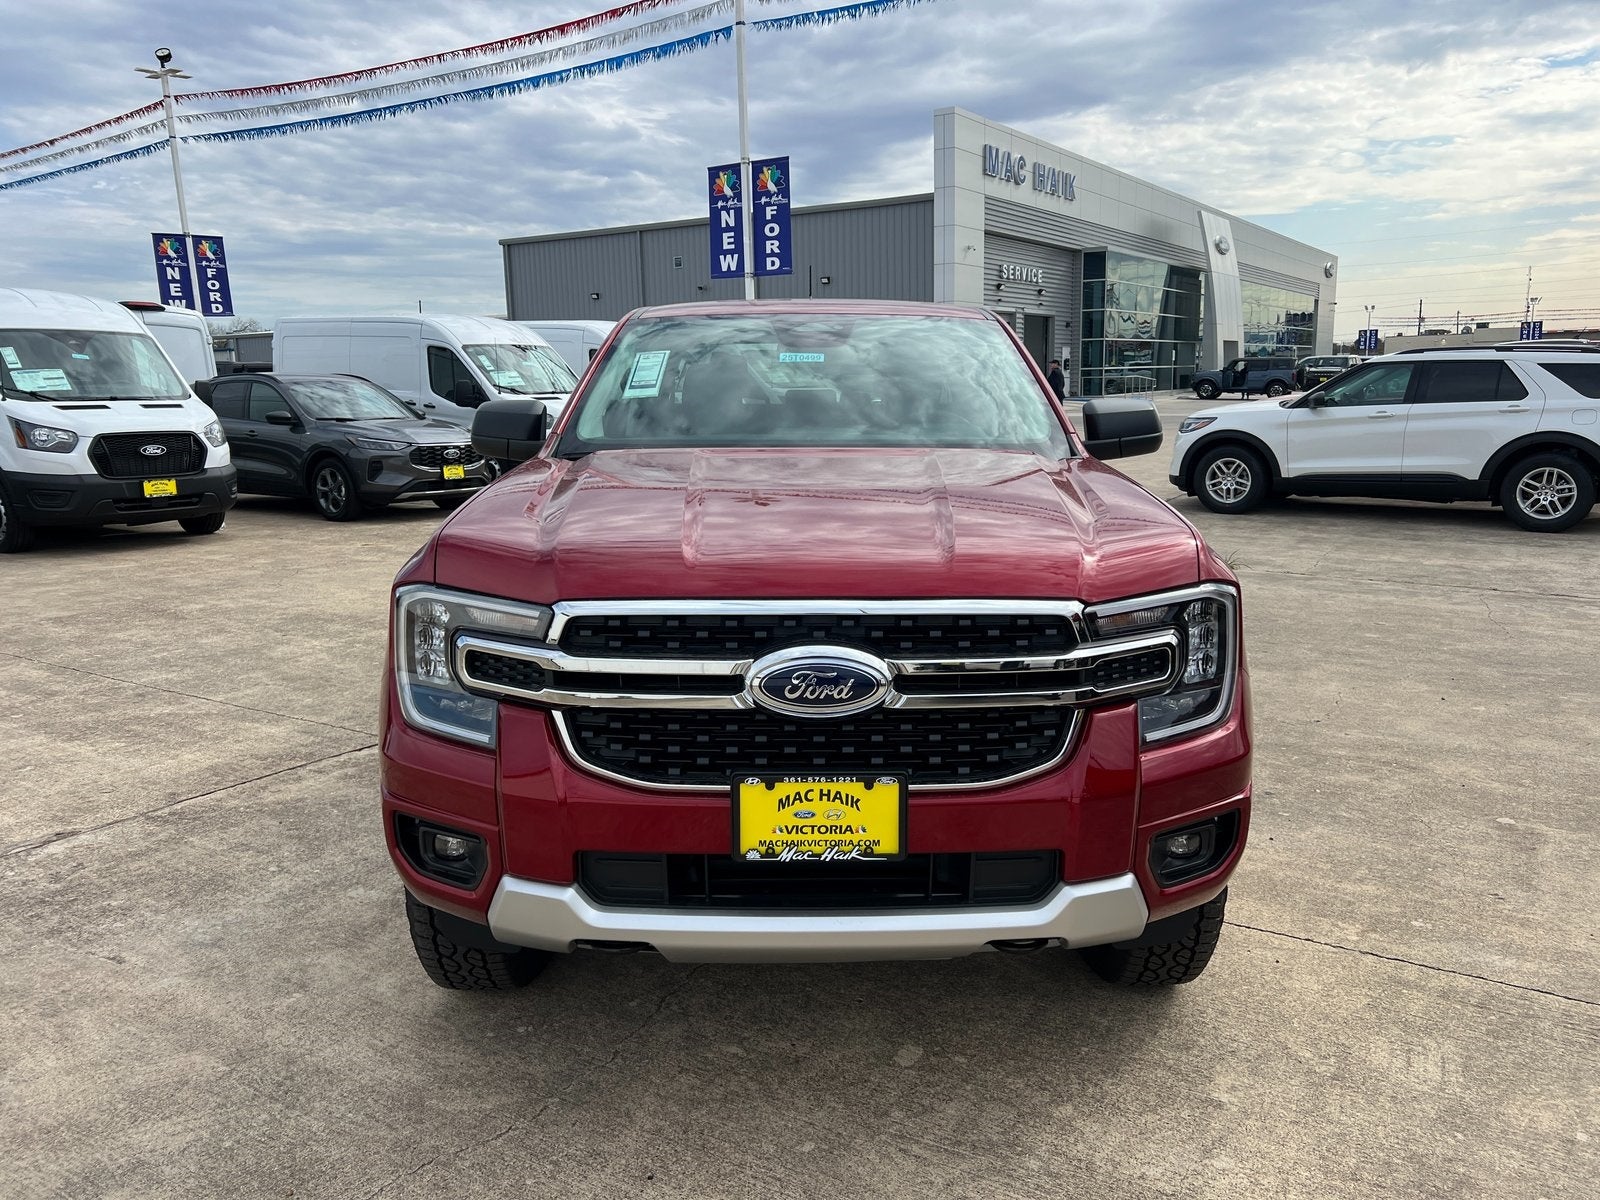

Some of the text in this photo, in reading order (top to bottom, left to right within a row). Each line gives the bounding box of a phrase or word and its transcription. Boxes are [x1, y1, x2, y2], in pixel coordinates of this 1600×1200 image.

[984, 144, 1077, 201] MAC HAIK
[719, 209, 738, 272] NEW
[764, 206, 780, 271] FORD
[1002, 264, 1043, 283] SERVICE
[206, 268, 224, 313] FORD
[784, 670, 855, 700] Ford
[777, 788, 861, 812] MAC HAIK
[795, 810, 814, 819] Ford
[785, 825, 854, 835] VICTORIA
[758, 839, 881, 848] MACHAIKVICTORIA.COM
[778, 845, 864, 862] Mac Haik
